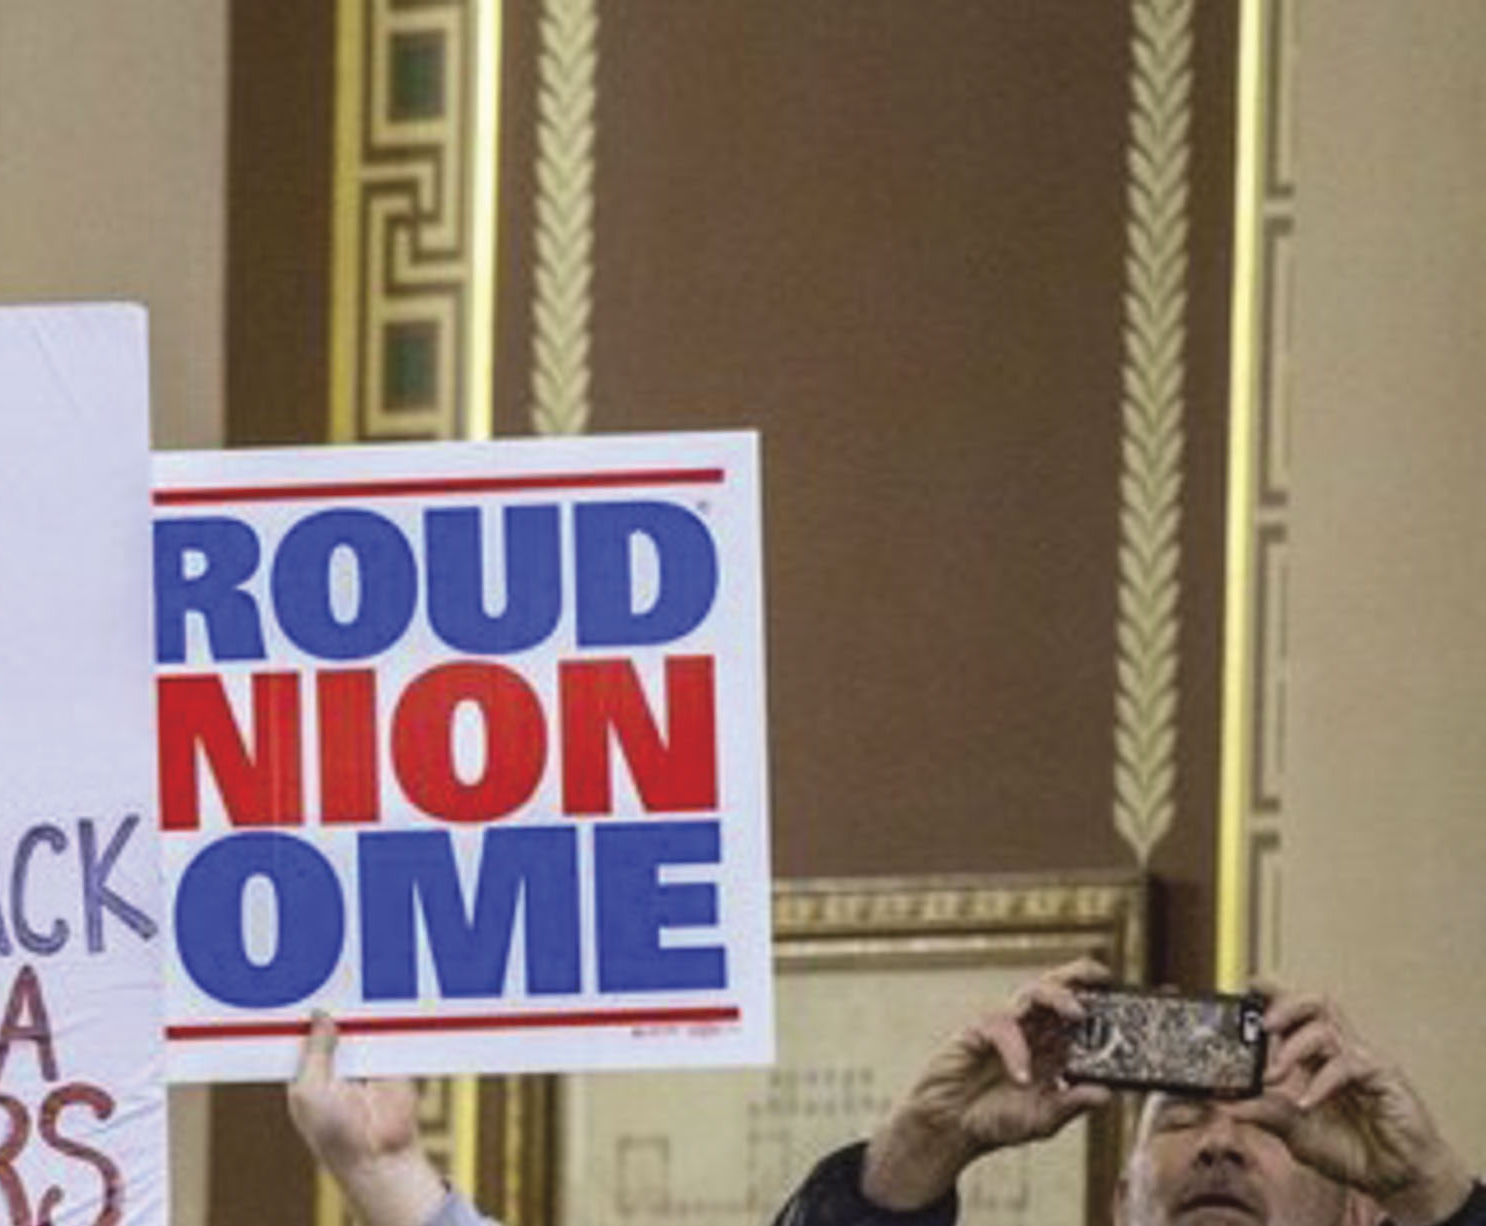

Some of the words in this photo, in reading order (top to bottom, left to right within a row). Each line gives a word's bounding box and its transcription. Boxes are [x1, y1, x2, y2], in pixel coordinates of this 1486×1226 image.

[152, 500, 720, 665] ROUD
[155, 655, 720, 832] NION
[173, 820, 729, 1010] OME
